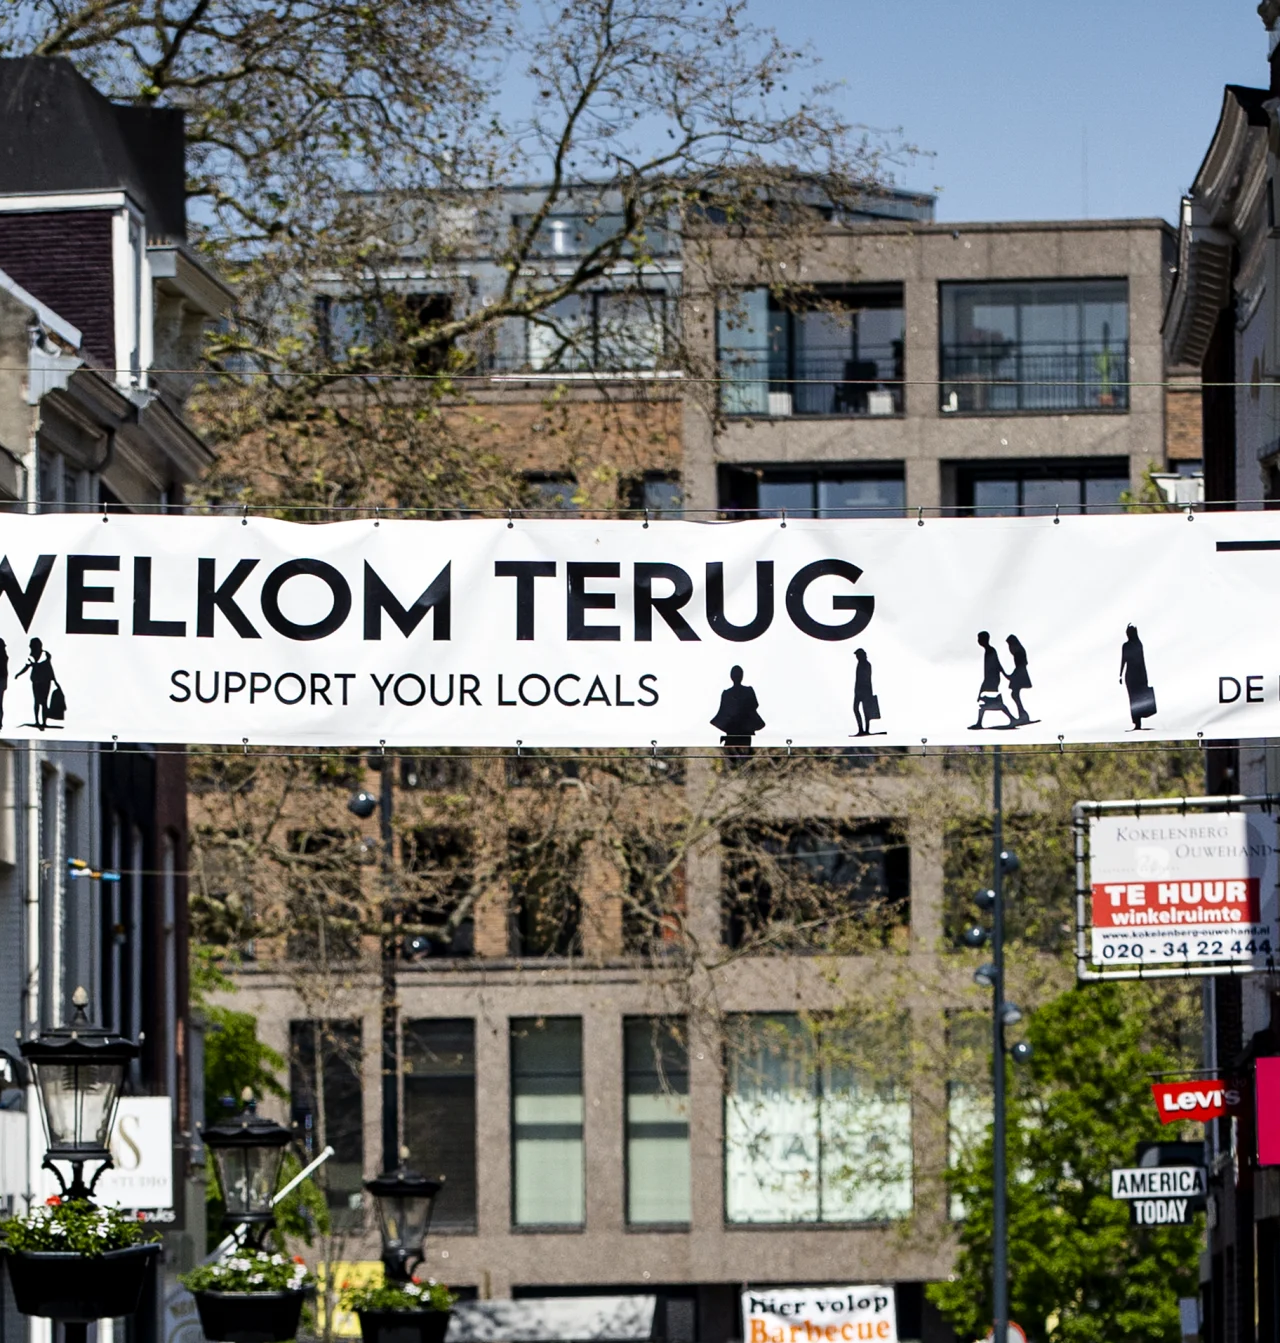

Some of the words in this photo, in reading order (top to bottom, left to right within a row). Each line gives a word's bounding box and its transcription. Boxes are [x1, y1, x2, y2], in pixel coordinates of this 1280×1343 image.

[494, 559, 876, 643] TERUG
[169, 669, 357, 706] SUPPORT
[369, 672, 483, 707] YOUR
[497, 673, 660, 708] LOCALS
[1218, 674, 1265, 704] DE
[1104, 884, 1146, 906] TE
[1158, 881, 1247, 905] HUUR
[1111, 906, 1242, 925] winkelruimte
[1102, 943, 1144, 959] 020
[1163, 942, 1188, 957] 34
[1197, 941, 1224, 956] 22
[1230, 939, 1272, 955] 444
[1116, 1169, 1206, 1194] AMERICA
[1133, 1200, 1188, 1225] TODAY
[816, 1294, 888, 1313] volop
